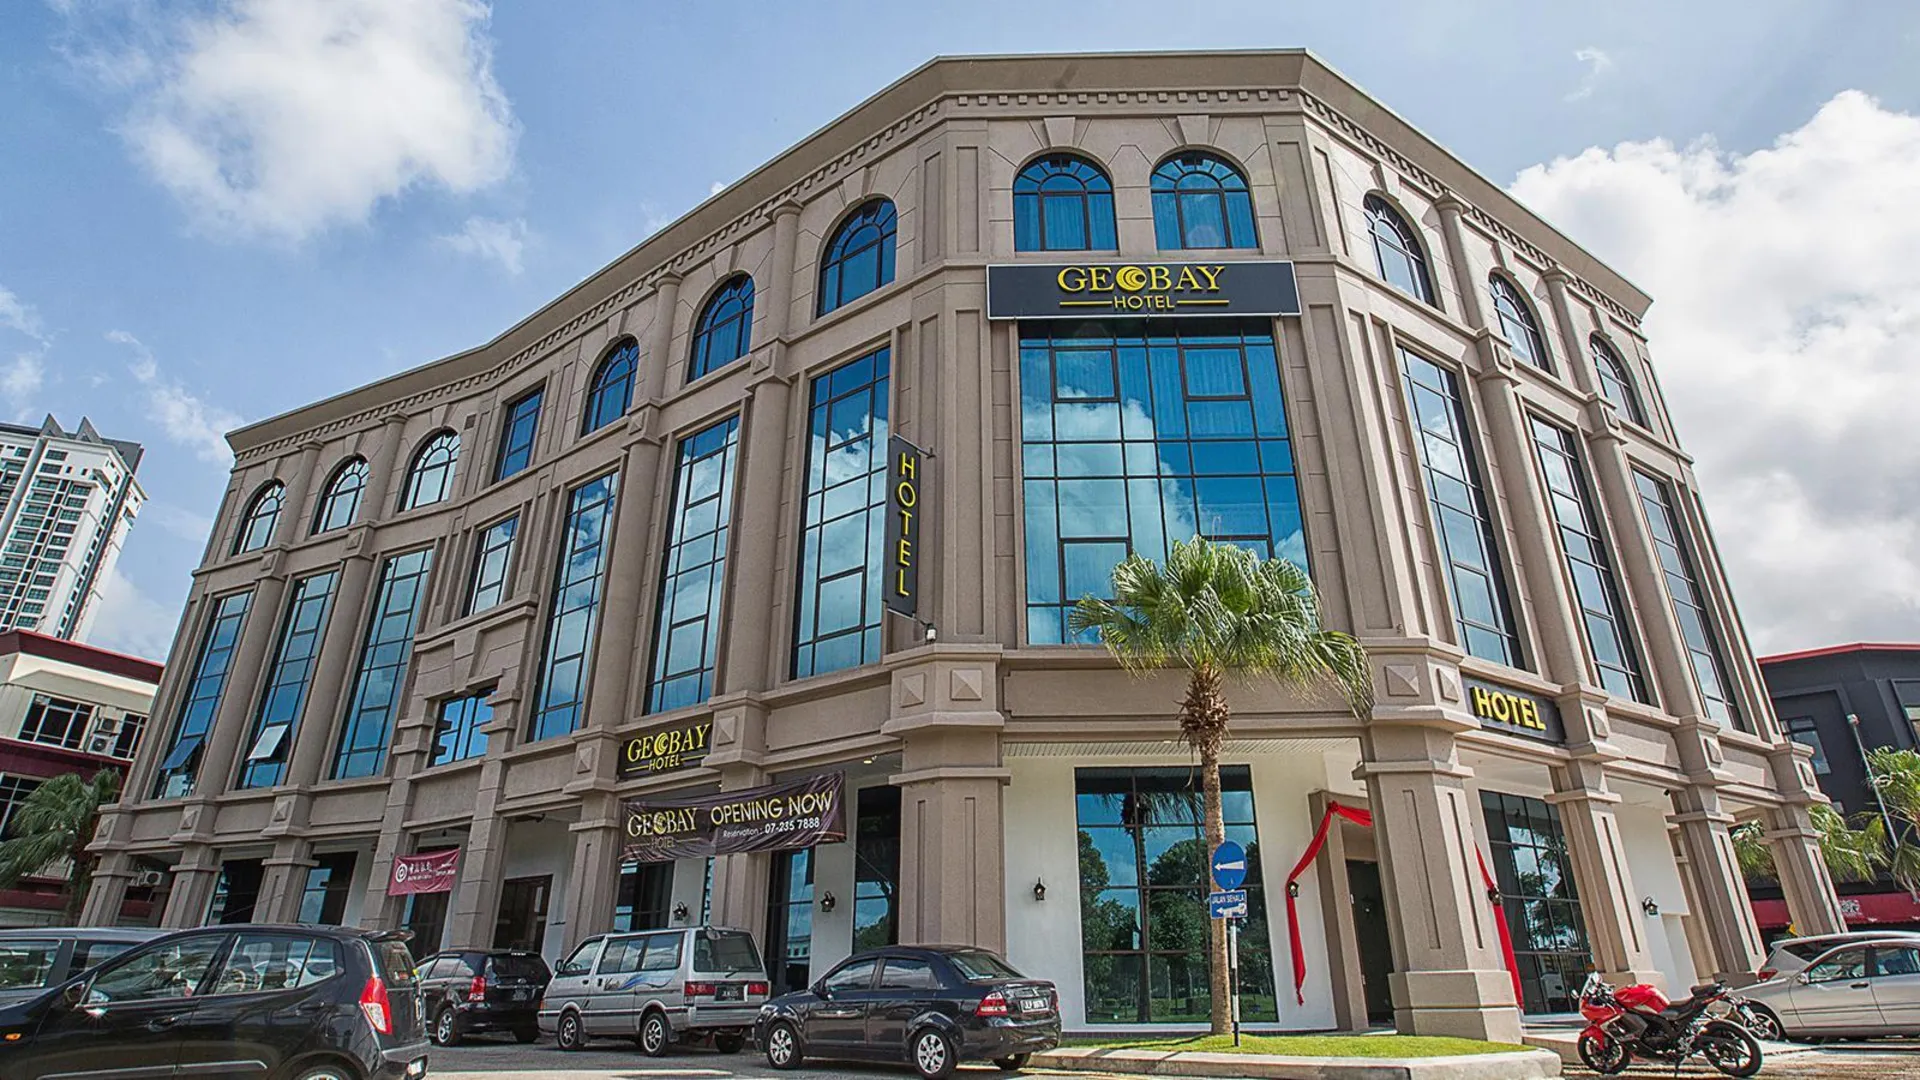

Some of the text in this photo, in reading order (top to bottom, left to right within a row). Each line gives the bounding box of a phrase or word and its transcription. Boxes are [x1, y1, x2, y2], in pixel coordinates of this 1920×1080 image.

[1057, 265, 1225, 292] GEOBAY
[1114, 295, 1175, 310] HOTEL
[899, 452, 917, 597] HOTEL
[1473, 686, 1547, 731] HOTEL
[627, 723, 711, 763] GEOBAY
[648, 754, 680, 771] HOTEL
[627, 807, 698, 838] GEOBAY
[710, 790, 834, 826] OPENING NOW
[723, 827, 759, 838] Reservation
[764, 820, 795, 834] 07-235
[797, 816, 820, 830] 7888
[651, 836, 675, 849] HOTEL
